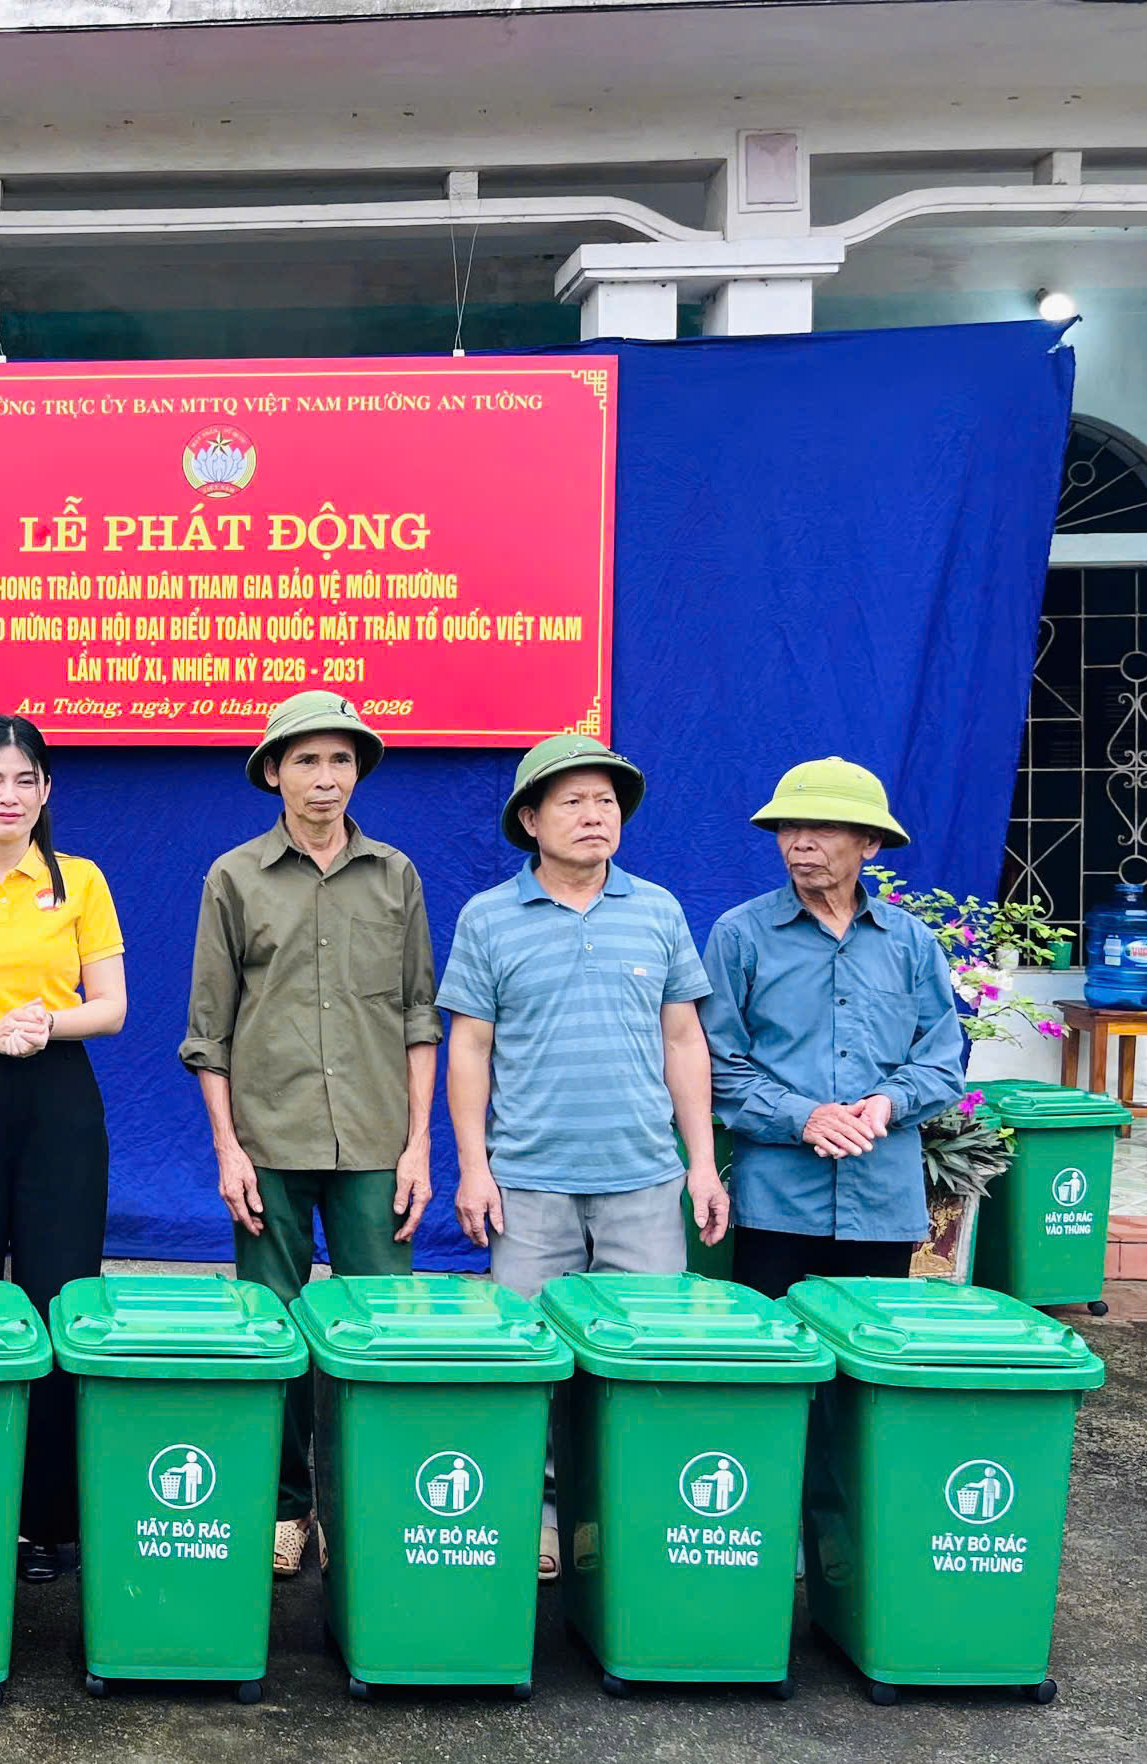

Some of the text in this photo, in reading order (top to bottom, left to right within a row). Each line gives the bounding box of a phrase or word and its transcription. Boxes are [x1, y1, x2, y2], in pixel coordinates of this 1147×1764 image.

[42, 398, 94, 418] TRỰC
[101, 396, 127, 414] ỦY
[134, 399, 174, 413] BAN
[180, 397, 238, 416] MTTQ
[244, 394, 291, 416] VIỆT
[297, 397, 341, 411] NAM
[347, 392, 430, 411] PHƯỜNG
[438, 395, 466, 410] AN
[472, 391, 542, 410] TƯỜNG
[20, 496, 430, 560] LỄ PHÁT ĐỘNG
[47, 571, 91, 600] TRÀO
[96, 571, 142, 600] TOÀN
[147, 571, 183, 599] DÂN
[188, 575, 238, 599] THAM
[244, 575, 273, 599] GIA
[278, 567, 314, 599] BẢO
[320, 570, 341, 604] VỆ
[346, 569, 380, 599] MÔI
[386, 569, 457, 598] TRƯỜNG
[11, 612, 62, 641] MỪNG
[67, 617, 96, 646] ĐẠI
[102, 614, 130, 646] HỘI
[136, 616, 164, 646] ĐẠI
[170, 609, 210, 640] BIỂU
[216, 614, 261, 640] TOÀN
[267, 609, 314, 643] QUỐC
[320, 612, 358, 646] MẶT
[363, 613, 410, 646] TRẬN
[416, 606, 437, 640] TỔ
[443, 609, 491, 643] QUỐC
[496, 613, 534, 646] VIỆT
[540, 616, 582, 640] NAM
[68, 651, 101, 681] LẦN
[106, 654, 141, 681] THỨ
[144, 658, 166, 684] XI,
[172, 654, 230, 686] NHIỆM
[235, 654, 258, 681] KỲ
[262, 658, 305, 682] 2026
[323, 658, 364, 682] 2031
[15, 699, 45, 714] An
[54, 698, 122, 718] Tường,
[130, 698, 185, 718] ngày
[190, 700, 214, 714] 10
[361, 699, 413, 715] 2026
[138, 1518, 230, 1539] HÃY BỎ RÁC
[405, 1525, 498, 1544] HÃY BỎ RÁC
[667, 1525, 761, 1546] HÃY BỎ RÁC
[139, 1539, 227, 1559] VÀO THÙNG
[932, 1533, 1026, 1552] HÃY BỎ RÁC
[406, 1545, 495, 1565] VÀO THÙNG
[668, 1546, 758, 1566] VÀO THÙNG
[933, 1553, 1022, 1572] VÀO THÙNG
